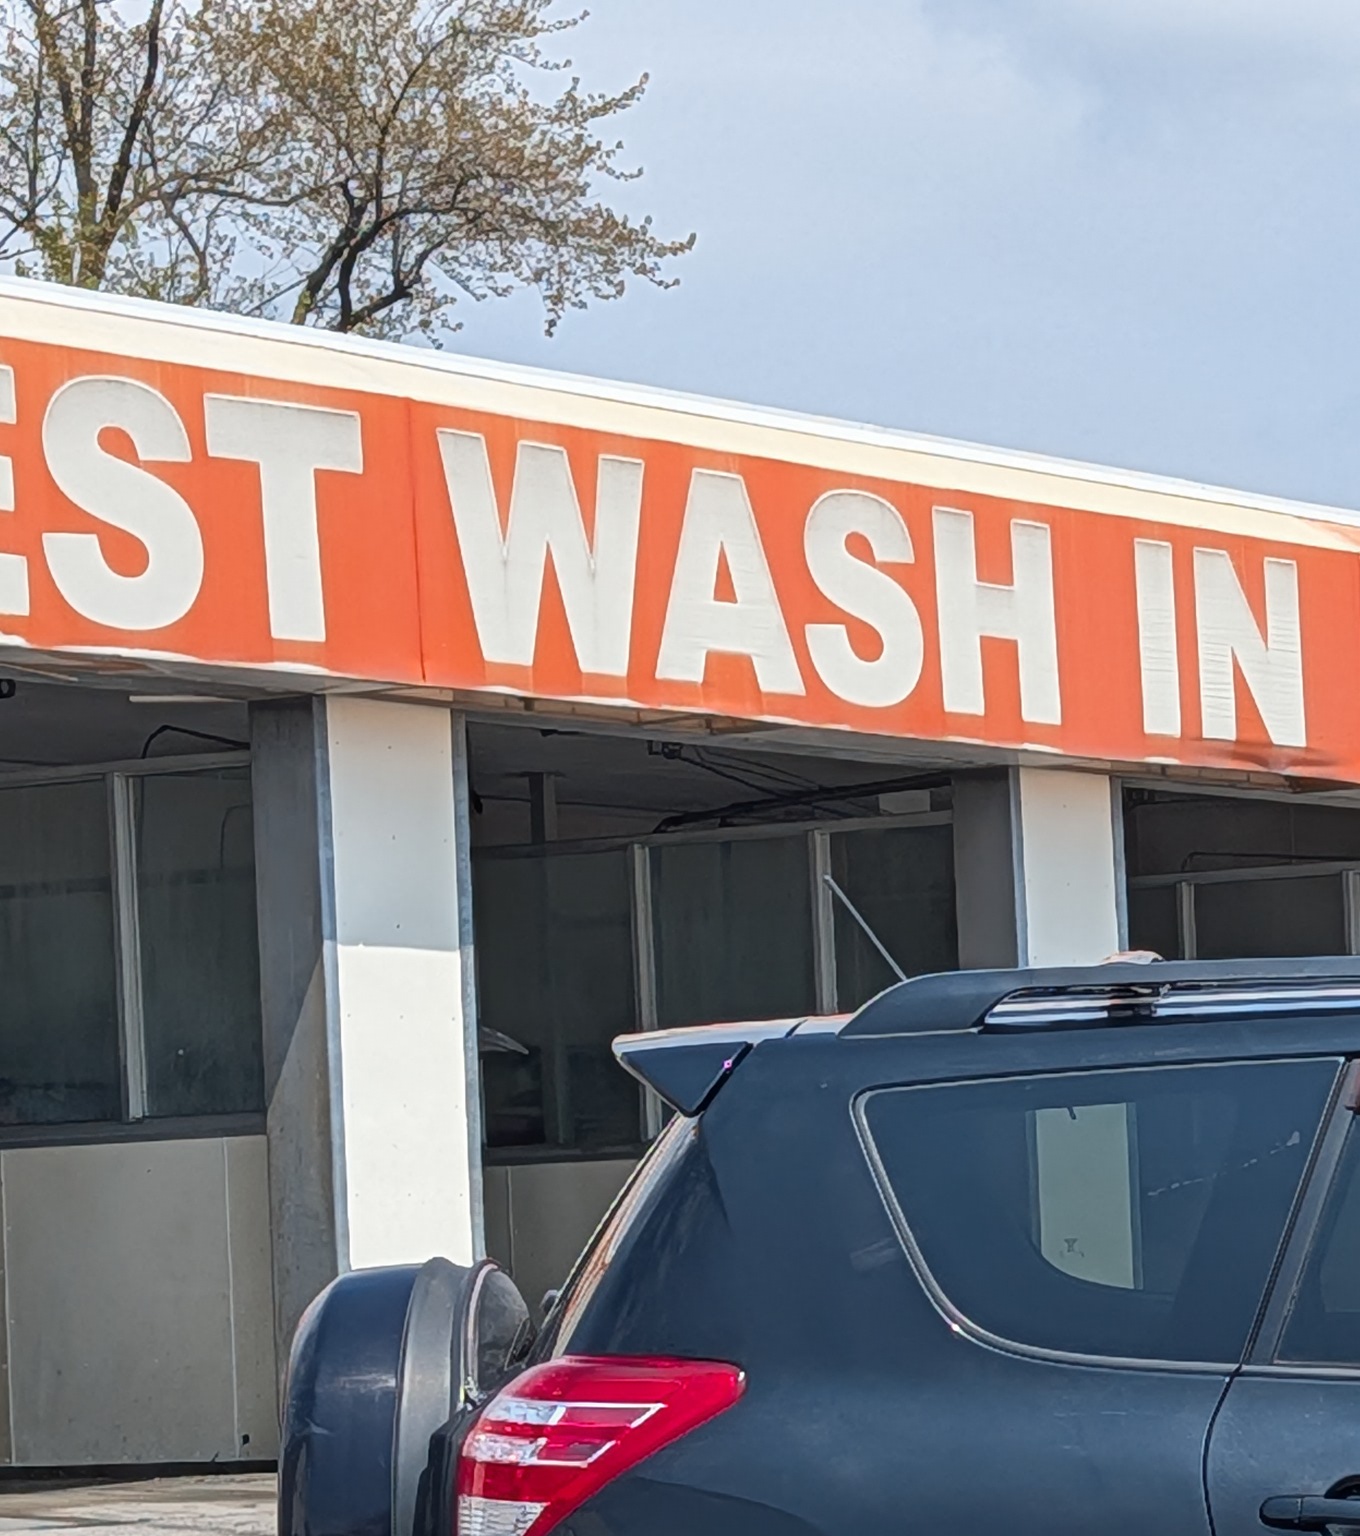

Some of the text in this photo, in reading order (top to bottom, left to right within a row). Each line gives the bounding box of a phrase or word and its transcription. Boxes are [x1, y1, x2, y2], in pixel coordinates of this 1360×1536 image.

[0, 364, 363, 642] ST
[436, 427, 1062, 726] WASH
[1133, 537, 1307, 749] IN
